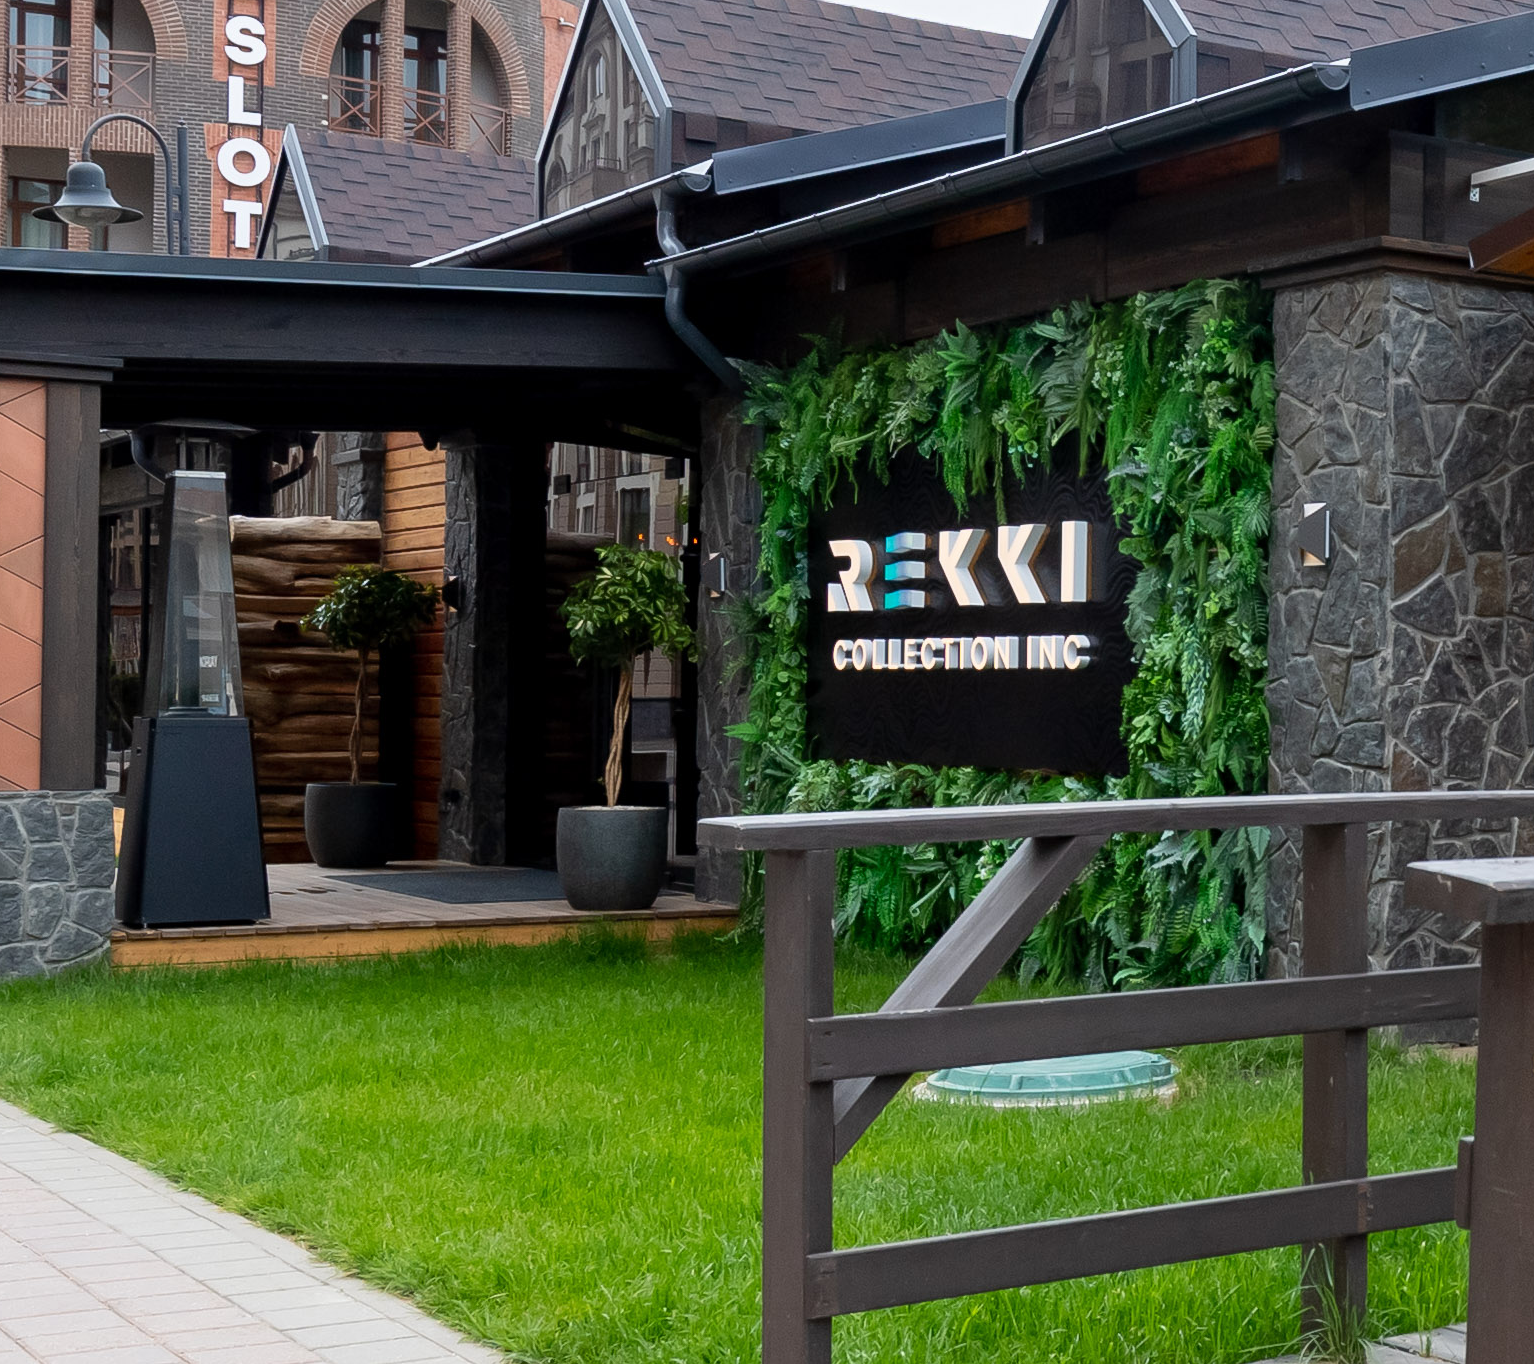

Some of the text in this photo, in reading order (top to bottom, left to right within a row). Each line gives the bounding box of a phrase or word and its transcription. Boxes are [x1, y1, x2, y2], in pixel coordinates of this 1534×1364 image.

[217, 15, 271, 248] SLOT
[827, 521, 1089, 612] REKKI
[833, 635, 1091, 670] COLLECTION INC
